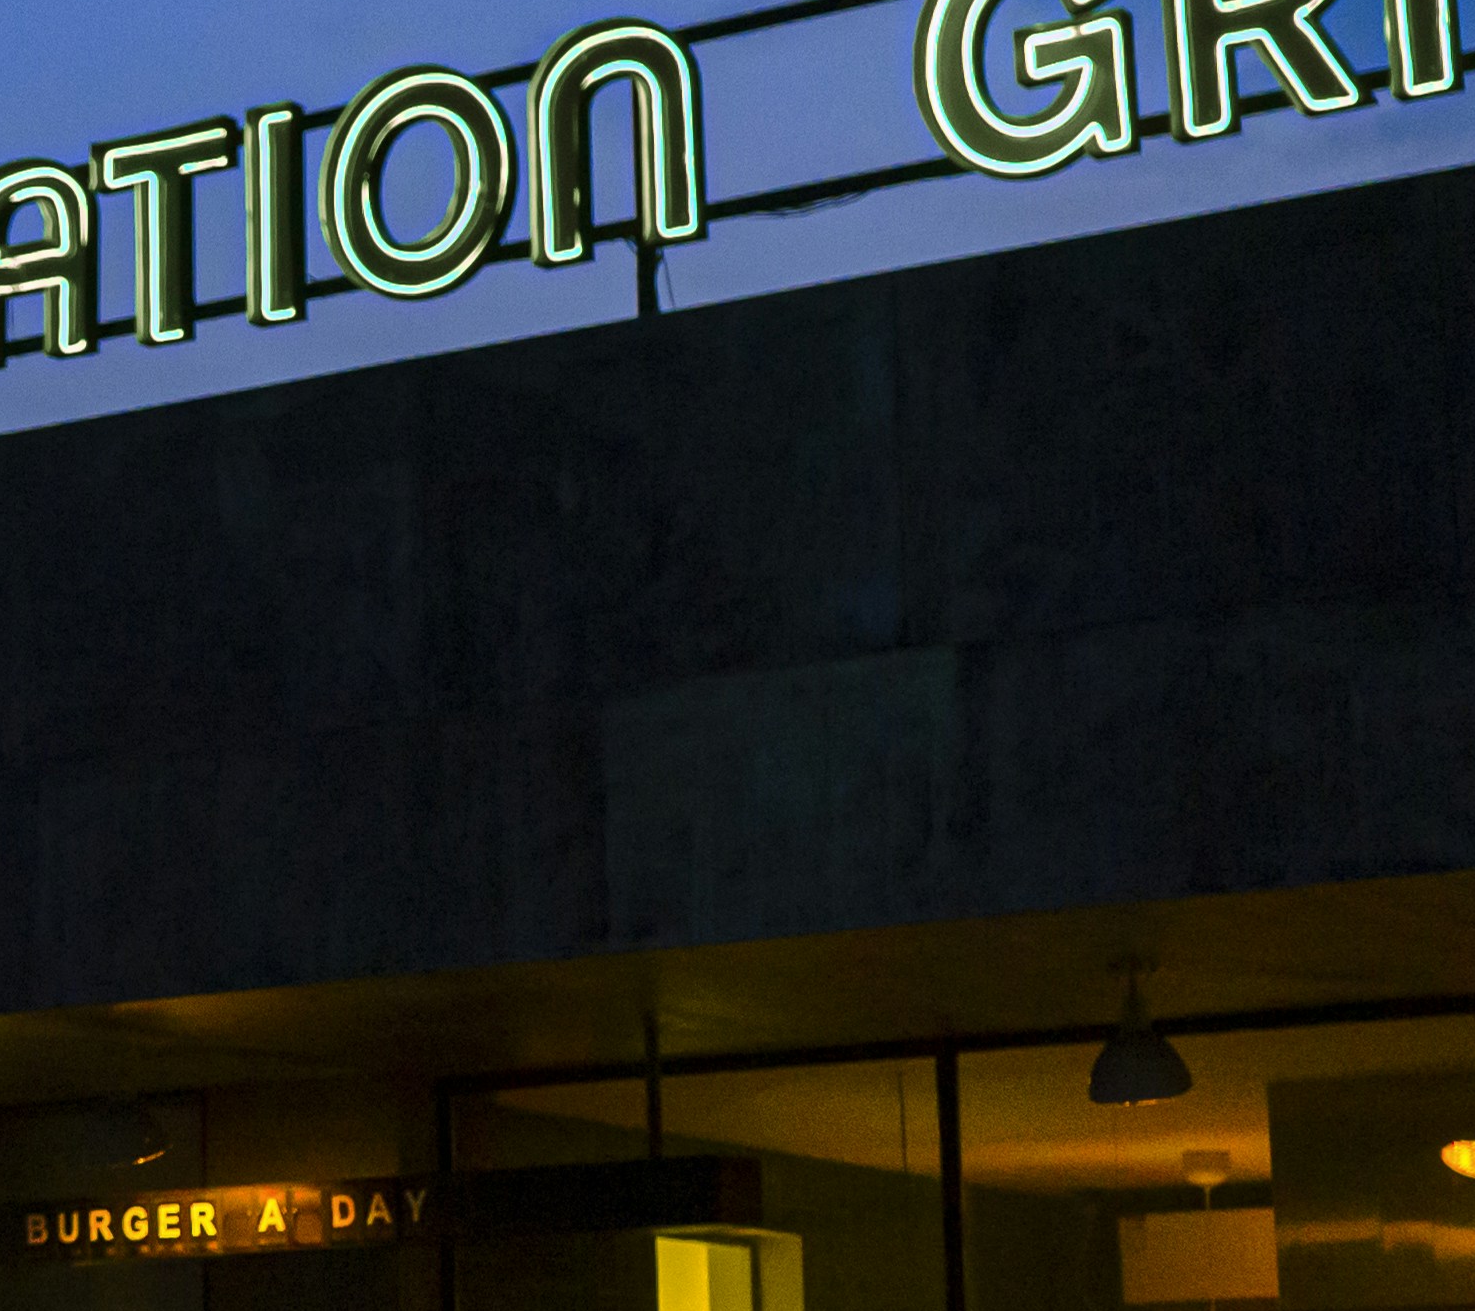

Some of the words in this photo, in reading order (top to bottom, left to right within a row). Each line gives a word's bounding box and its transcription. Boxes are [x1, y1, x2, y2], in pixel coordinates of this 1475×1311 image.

[26, 1201, 218, 1245] BURGER
[258, 1197, 286, 1234] A
[331, 1189, 428, 1230] DAY
